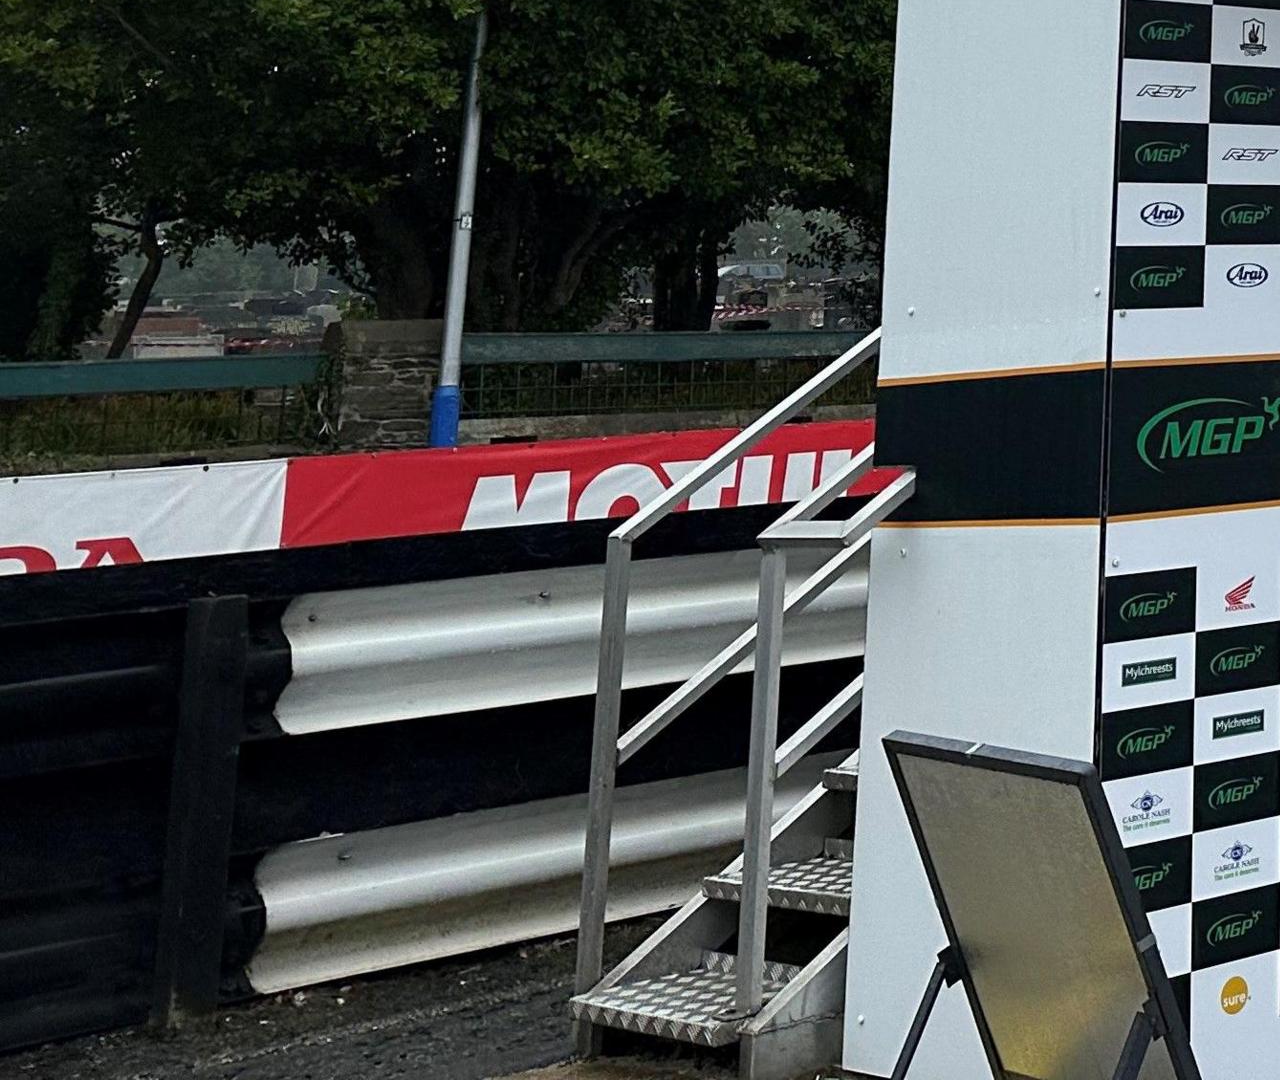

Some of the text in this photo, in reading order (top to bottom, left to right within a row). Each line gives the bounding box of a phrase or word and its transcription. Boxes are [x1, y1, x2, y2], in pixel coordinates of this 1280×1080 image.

[1145, 25, 1185, 41] MGP
[1135, 83, 1197, 99] RST
[1230, 90, 1268, 105] MGP
[1141, 147, 1181, 162] MGP
[1221, 147, 1279, 161] RST
[1145, 203, 1178, 220] Arai
[1227, 209, 1265, 224] MGP
[1135, 272, 1177, 287] MGP
[1232, 265, 1263, 280] Arai
[1159, 416, 1265, 459] MGP
[1126, 598, 1168, 618] MGP
[1224, 601, 1256, 612] HONDA
[1217, 651, 1256, 672] MGP
[1124, 661, 1173, 680] Mylchreests
[1215, 713, 1261, 732] Mylchreests
[1123, 732, 1165, 754] MGP
[1215, 783, 1254, 806] MGP
[1214, 917, 1253, 942] MGP
[1222, 991, 1247, 1008] sure
